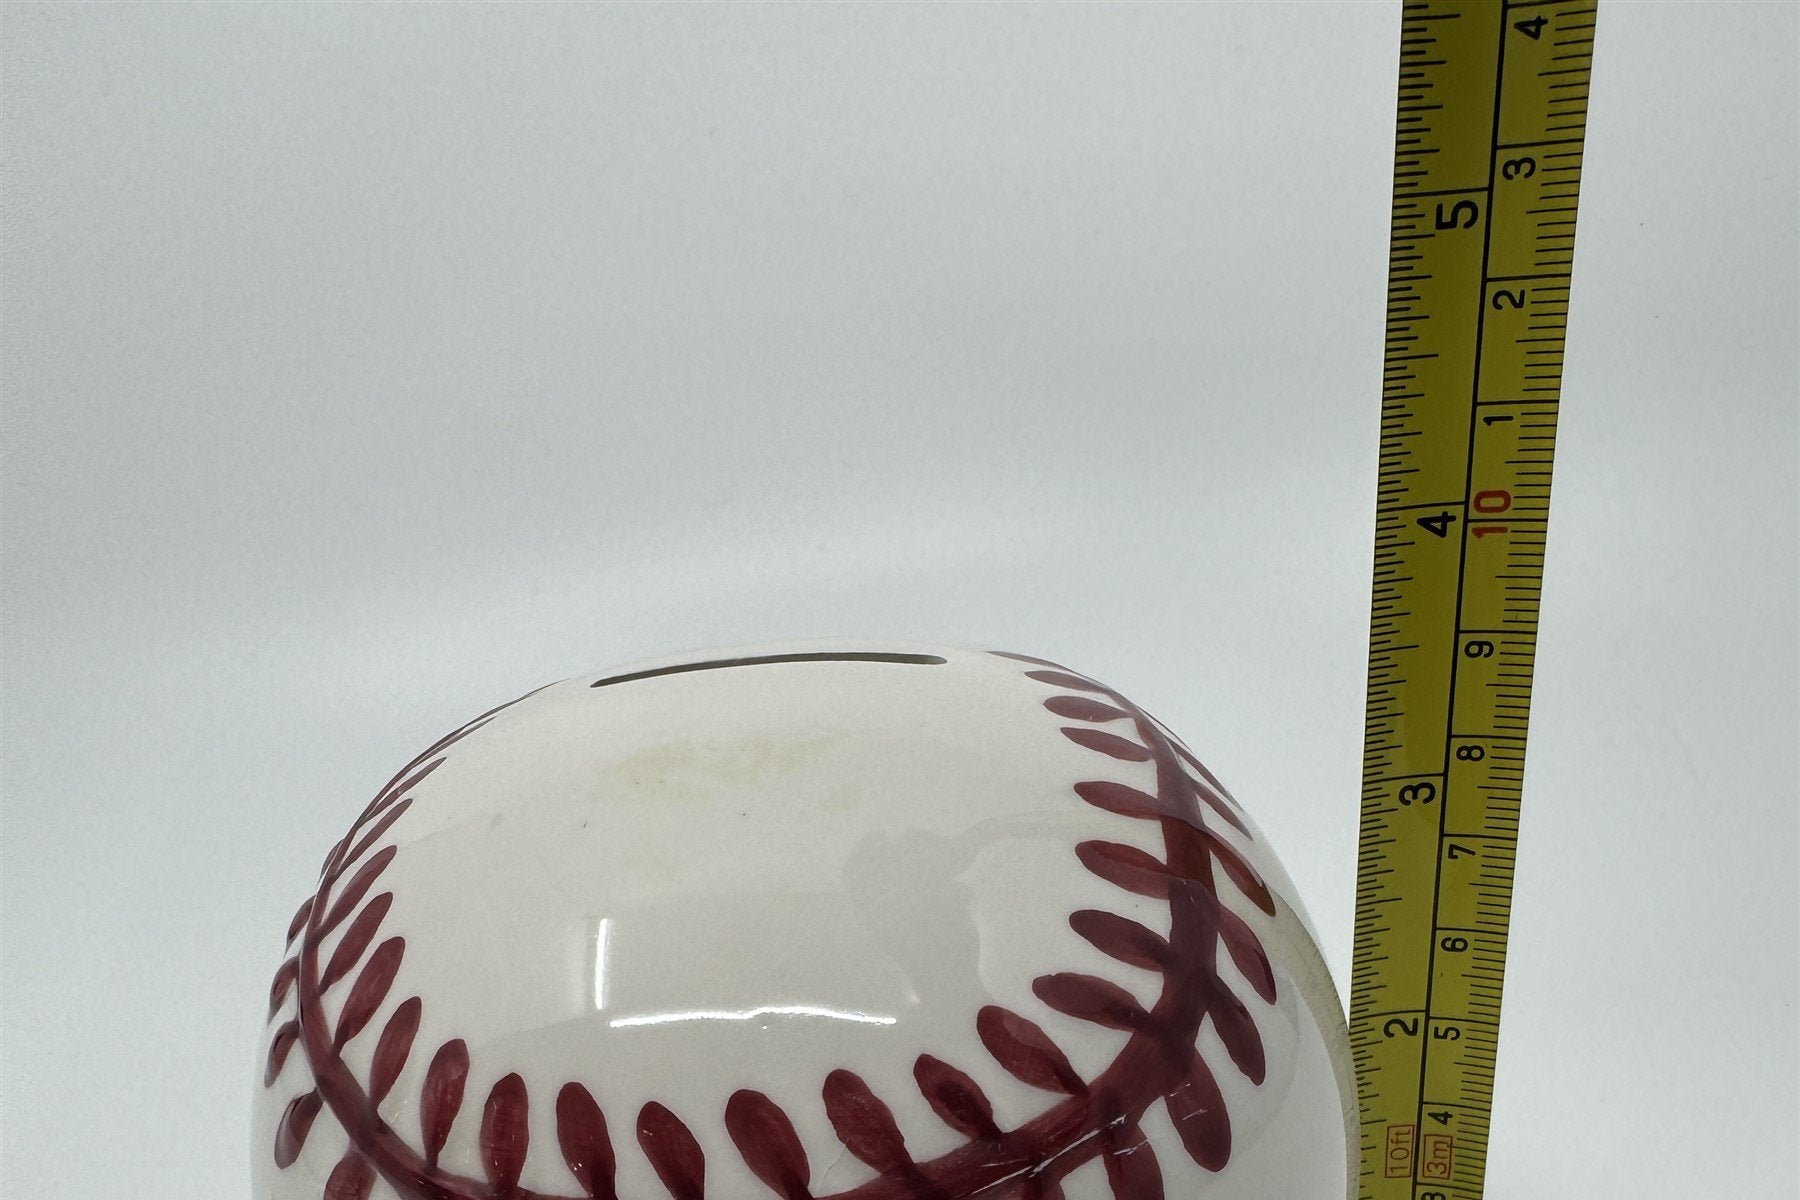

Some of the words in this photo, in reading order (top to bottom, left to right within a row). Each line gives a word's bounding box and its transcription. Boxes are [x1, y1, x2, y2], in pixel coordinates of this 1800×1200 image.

[1513, 15, 1549, 40] 4
[1502, 157, 1536, 181] 3
[1435, 200, 1479, 229] 5
[1492, 289, 1526, 310] 2
[1483, 415, 1514, 427] 1
[1416, 511, 1457, 538] 4
[1471, 490, 1512, 539] 10
[1464, 640, 1495, 659] 9
[1456, 744, 1485, 762] 8
[1398, 782, 1436, 806] 3
[1447, 843, 1476, 860] 7
[1440, 936, 1469, 952] 6
[1383, 1017, 1419, 1038] 2
[1433, 1026, 1461, 1041] 5
[1427, 1111, 1453, 1126] 4
[1389, 1128, 1411, 1174] 10ft
[1426, 1139, 1451, 1175] 3m
